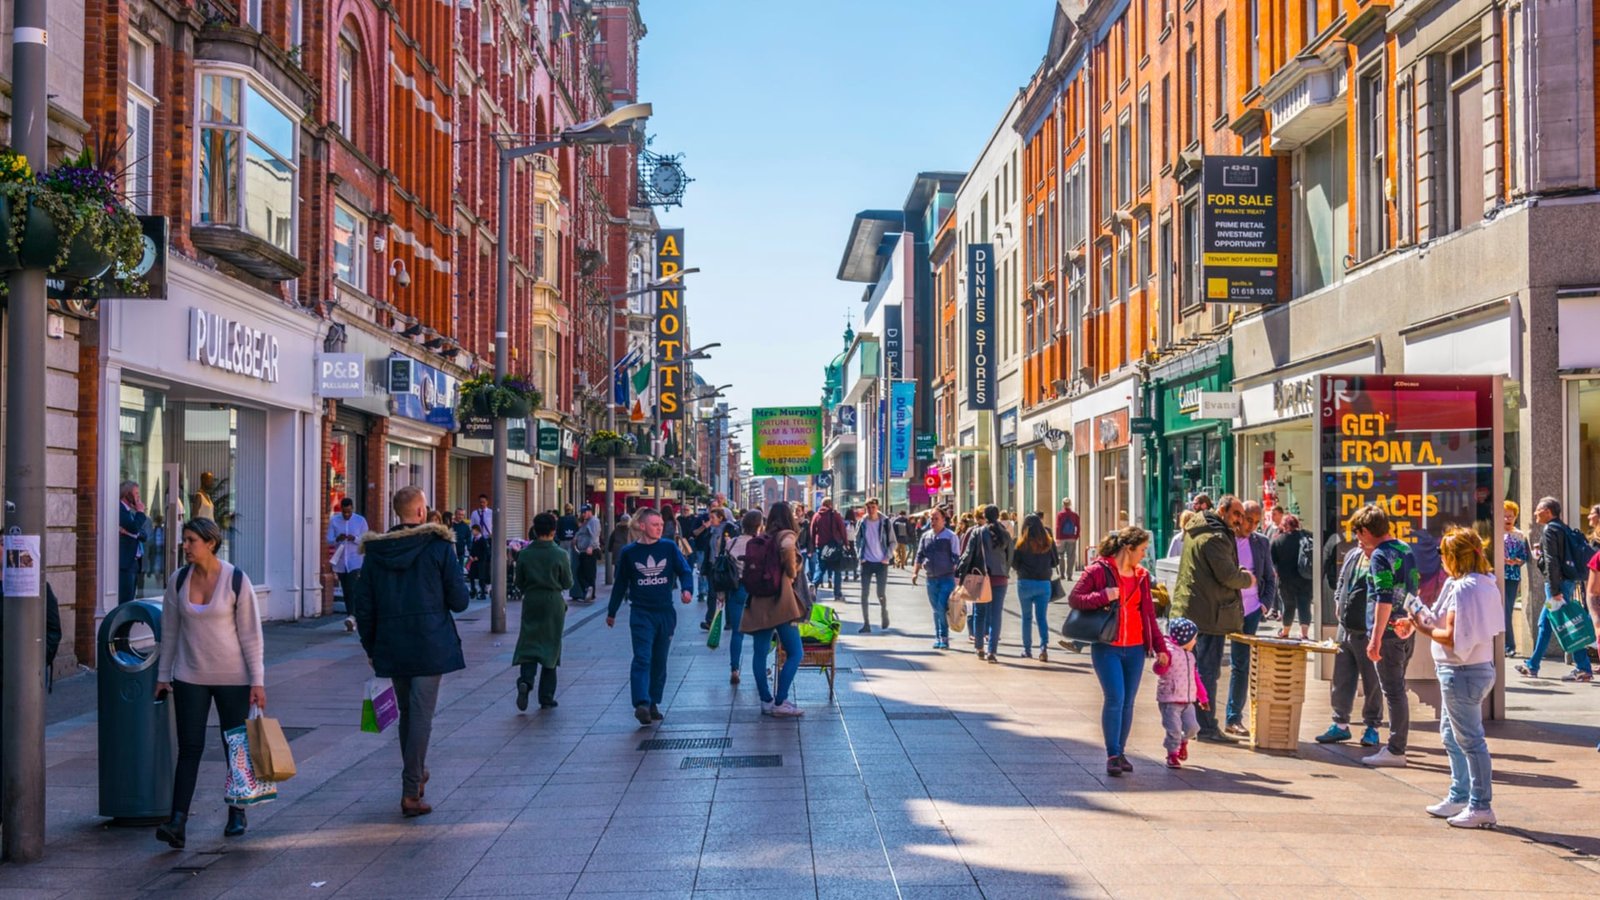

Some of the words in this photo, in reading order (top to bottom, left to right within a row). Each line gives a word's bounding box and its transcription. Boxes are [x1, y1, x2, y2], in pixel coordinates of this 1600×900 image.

[1207, 194, 1235, 205] FOR
[1239, 194, 1273, 206] SALE
[976, 250, 986, 322] DUNNES
[659, 235, 680, 413] ARNOTTS
[190, 307, 279, 382] PULL&BEAR
[323, 361, 360, 378] P&B
[975, 329, 987, 404] STORES
[780, 408, 818, 417] Murphy
[1204, 401, 1236, 409] Evans
[1342, 412, 1389, 436] GET
[1342, 440, 1411, 463] FROM
[1342, 467, 1374, 489] TO
[637, 576, 668, 586] adidas
